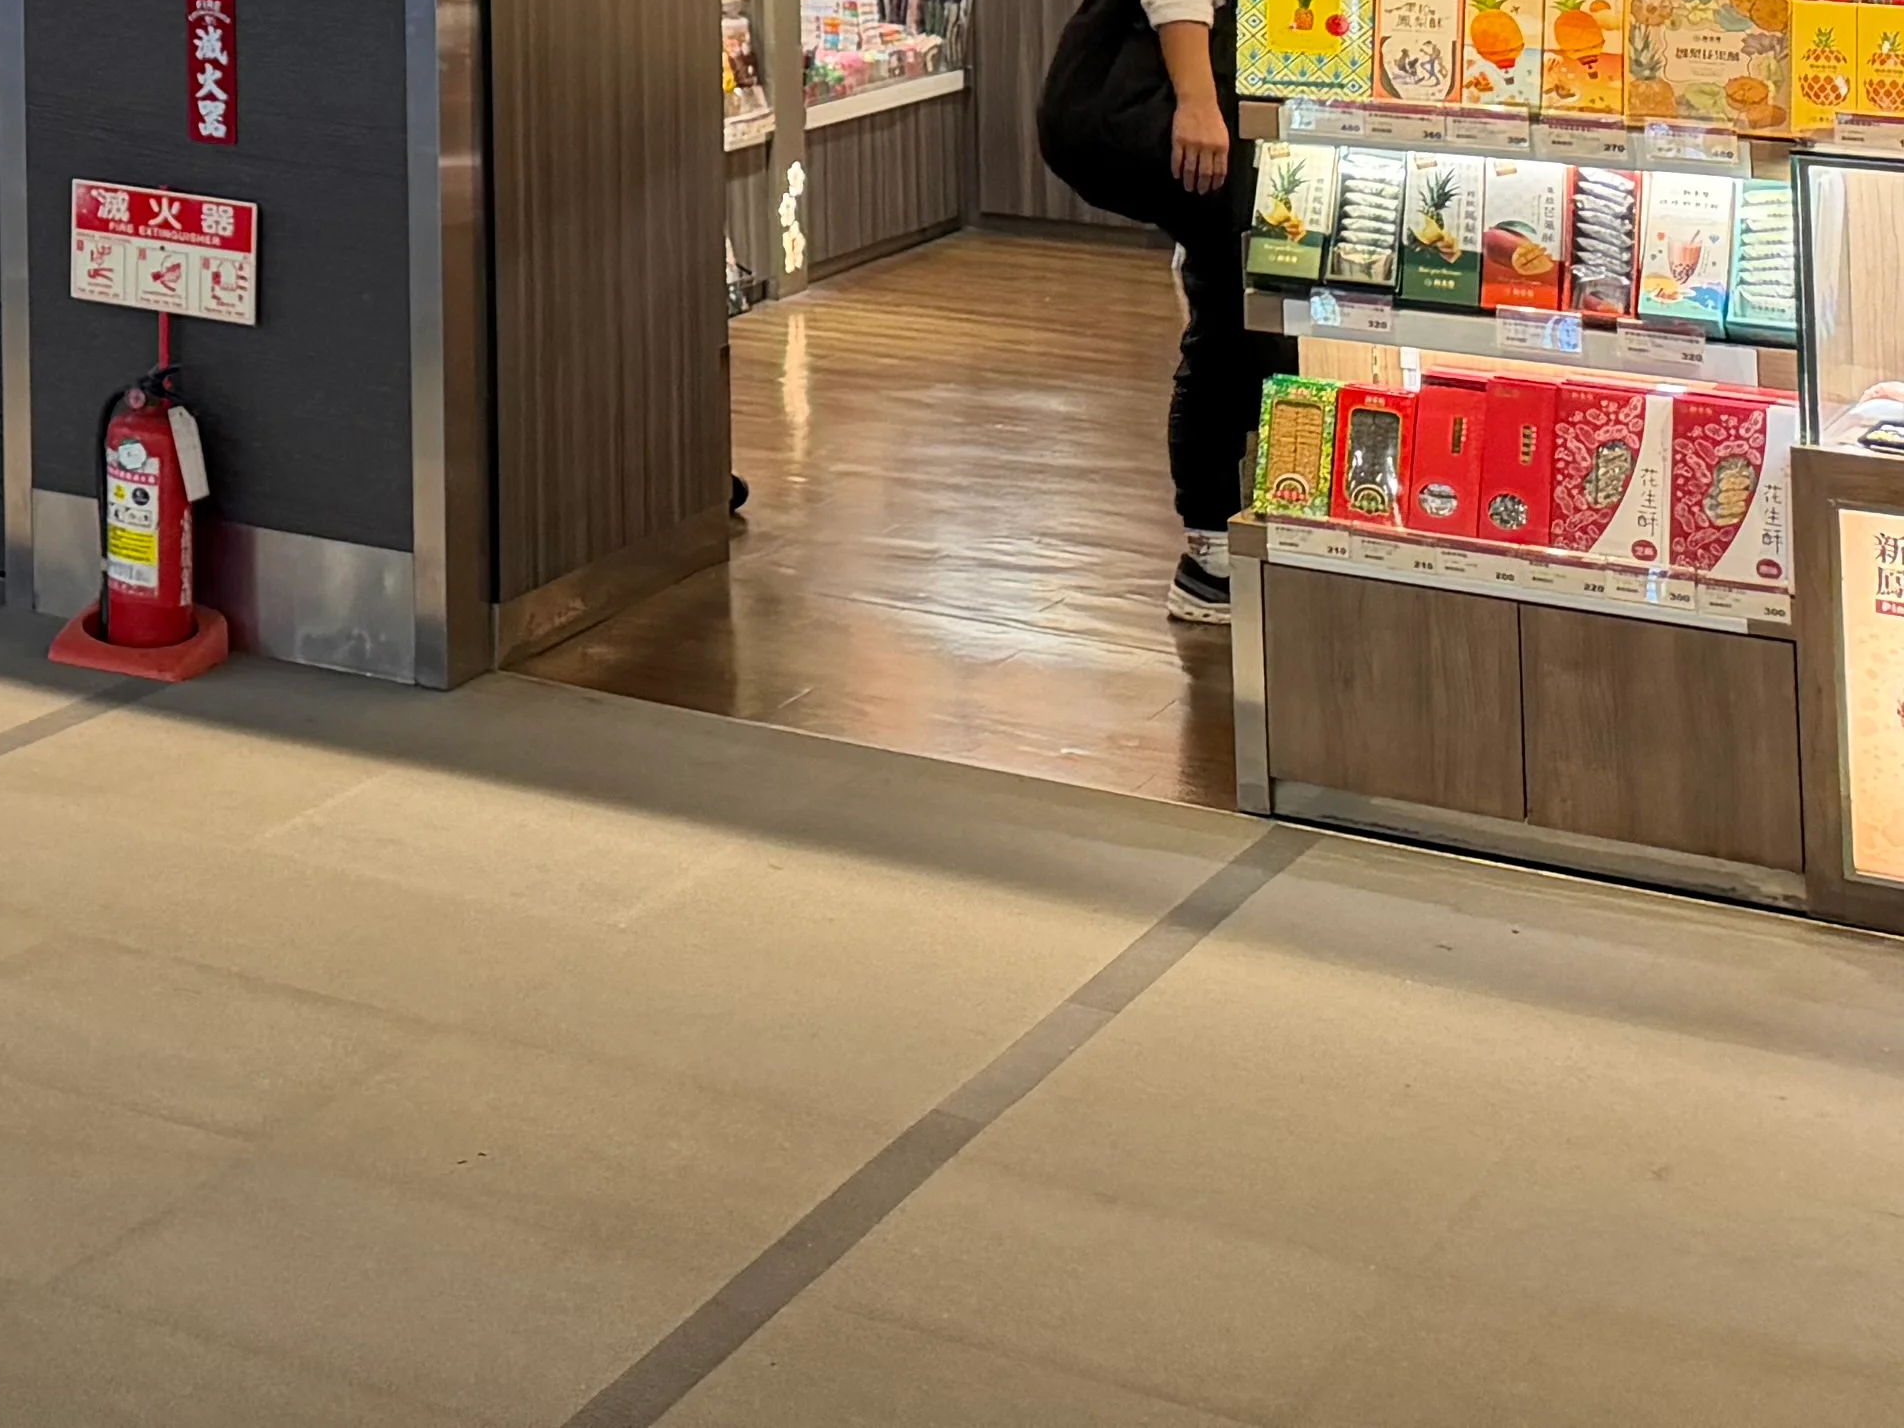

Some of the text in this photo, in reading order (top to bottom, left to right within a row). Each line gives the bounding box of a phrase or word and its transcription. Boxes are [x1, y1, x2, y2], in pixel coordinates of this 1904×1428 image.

[193, 25, 229, 138] 滅火器
[90, 188, 236, 238] 滅火器
[108, 221, 221, 246] FIRE EXTINGUISHER
